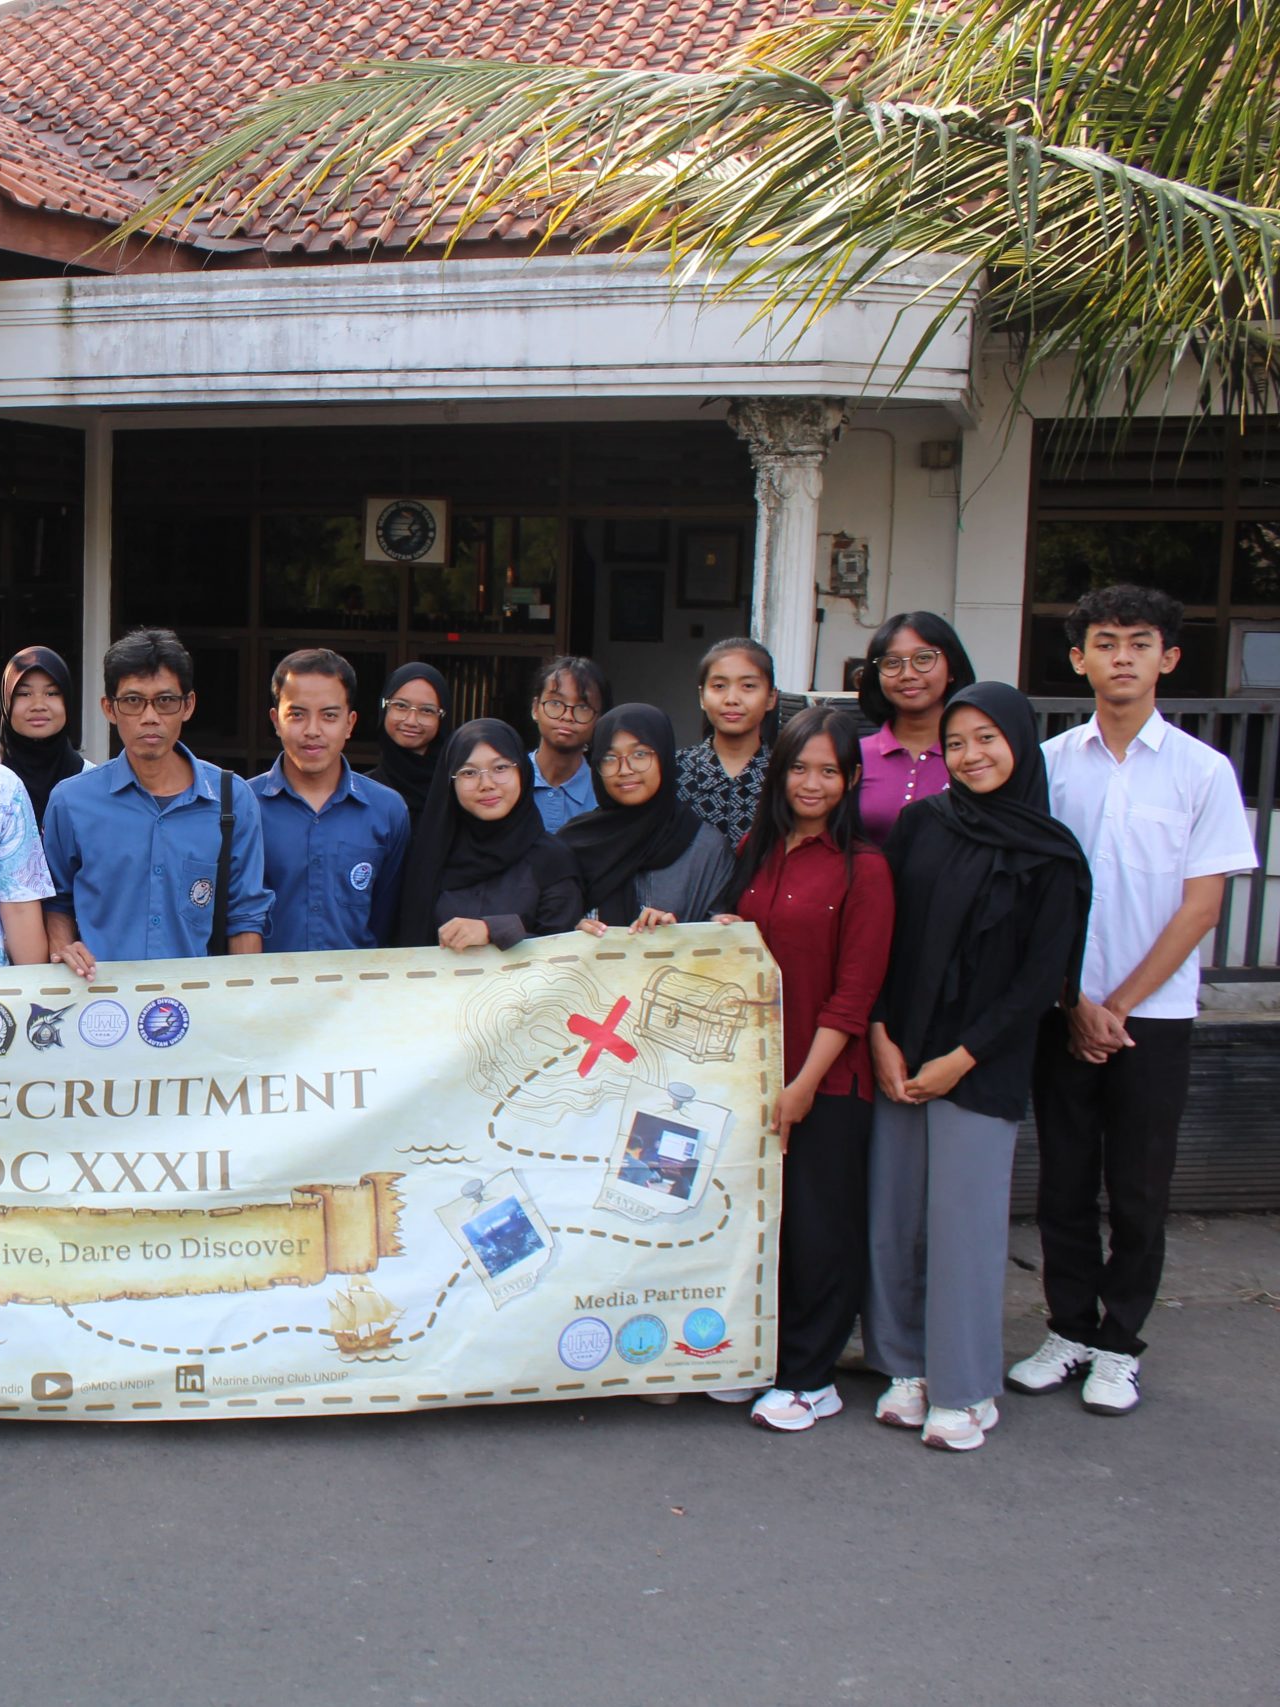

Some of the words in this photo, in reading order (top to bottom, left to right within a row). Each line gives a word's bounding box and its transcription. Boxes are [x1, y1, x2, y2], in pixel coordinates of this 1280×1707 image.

[138, 1001, 157, 1023] MARINE
[156, 998, 180, 1008] DIVING
[178, 1004, 189, 1023] CLUB
[139, 1028, 169, 1048] KELAUTAN
[169, 1028, 186, 1045] UNDIP
[70, 1149, 233, 1192] XXXII
[58, 1239, 132, 1264] Dare
[139, 1240, 172, 1261] to
[180, 1235, 312, 1259] Discover
[573, 1291, 639, 1310] Media
[643, 1286, 727, 1303] Partner
[80, 1381, 118, 1393] @MDC
[119, 1379, 155, 1391] UNDIP
[211, 1375, 249, 1386] Marine
[251, 1373, 284, 1387] Diving
[286, 1372, 312, 1383] Club
[314, 1371, 350, 1383] UNDIP
